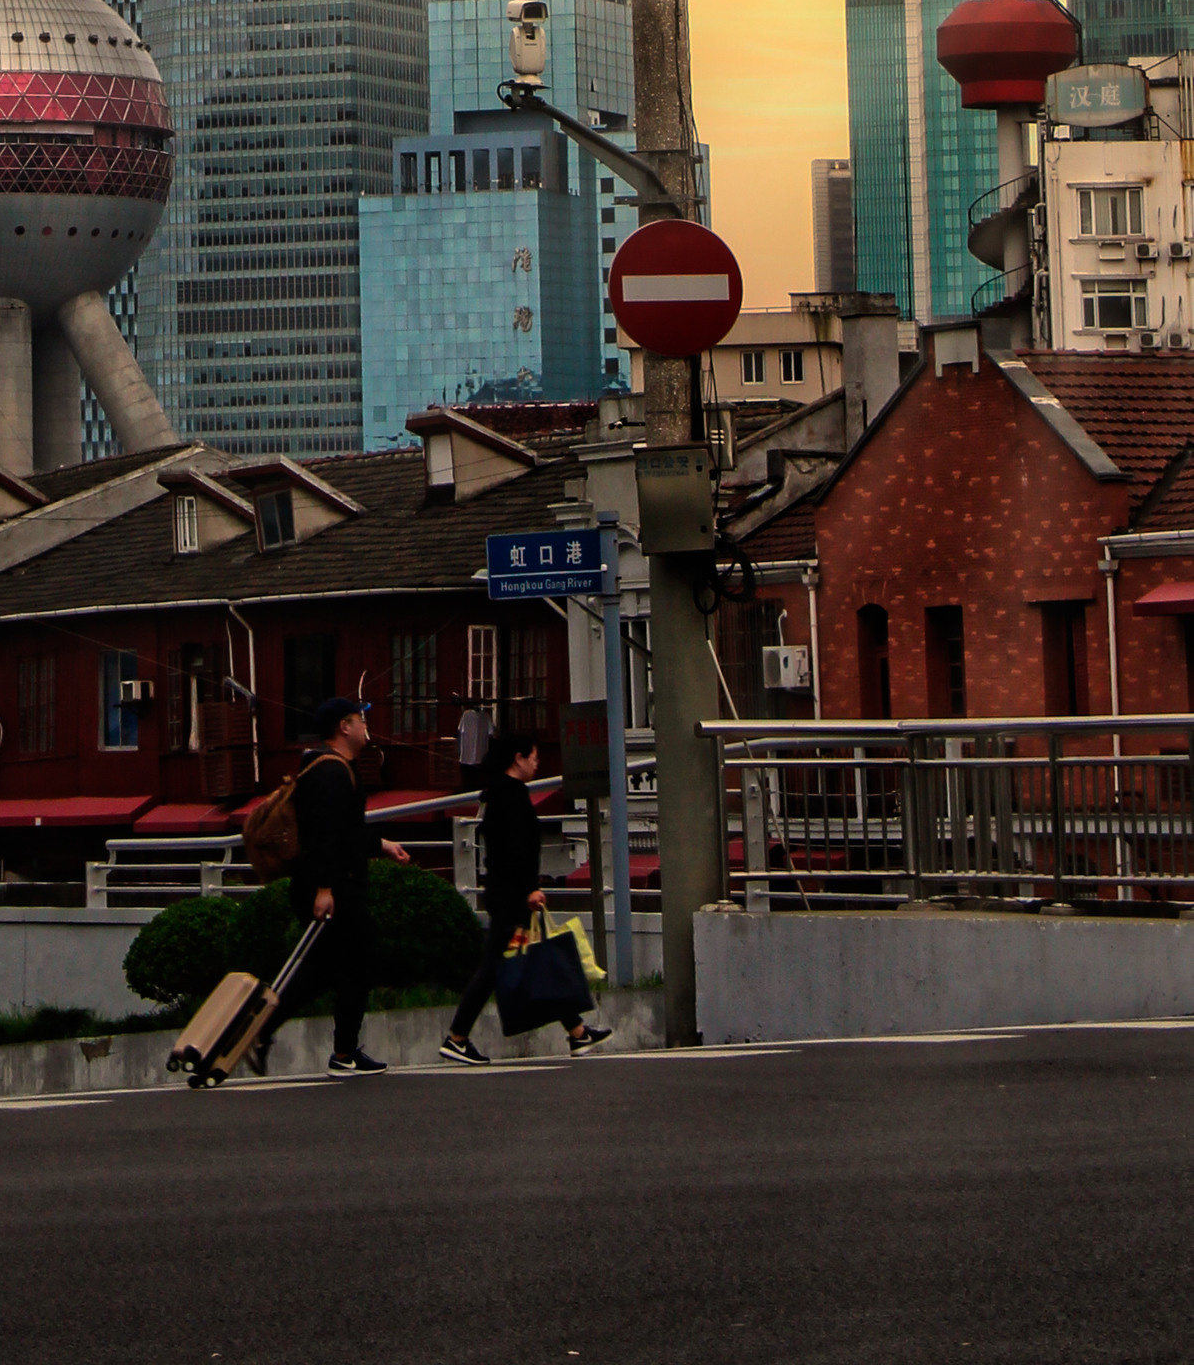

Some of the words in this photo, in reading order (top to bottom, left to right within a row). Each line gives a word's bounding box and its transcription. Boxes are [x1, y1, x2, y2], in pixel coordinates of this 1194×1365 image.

[1069, 82, 1121, 109] 汉庭
[510, 541, 582, 567] 虹口港
[501, 580, 543, 593] Hongkou
[545, 578, 566, 591] Gang
[567, 577, 592, 588] River
